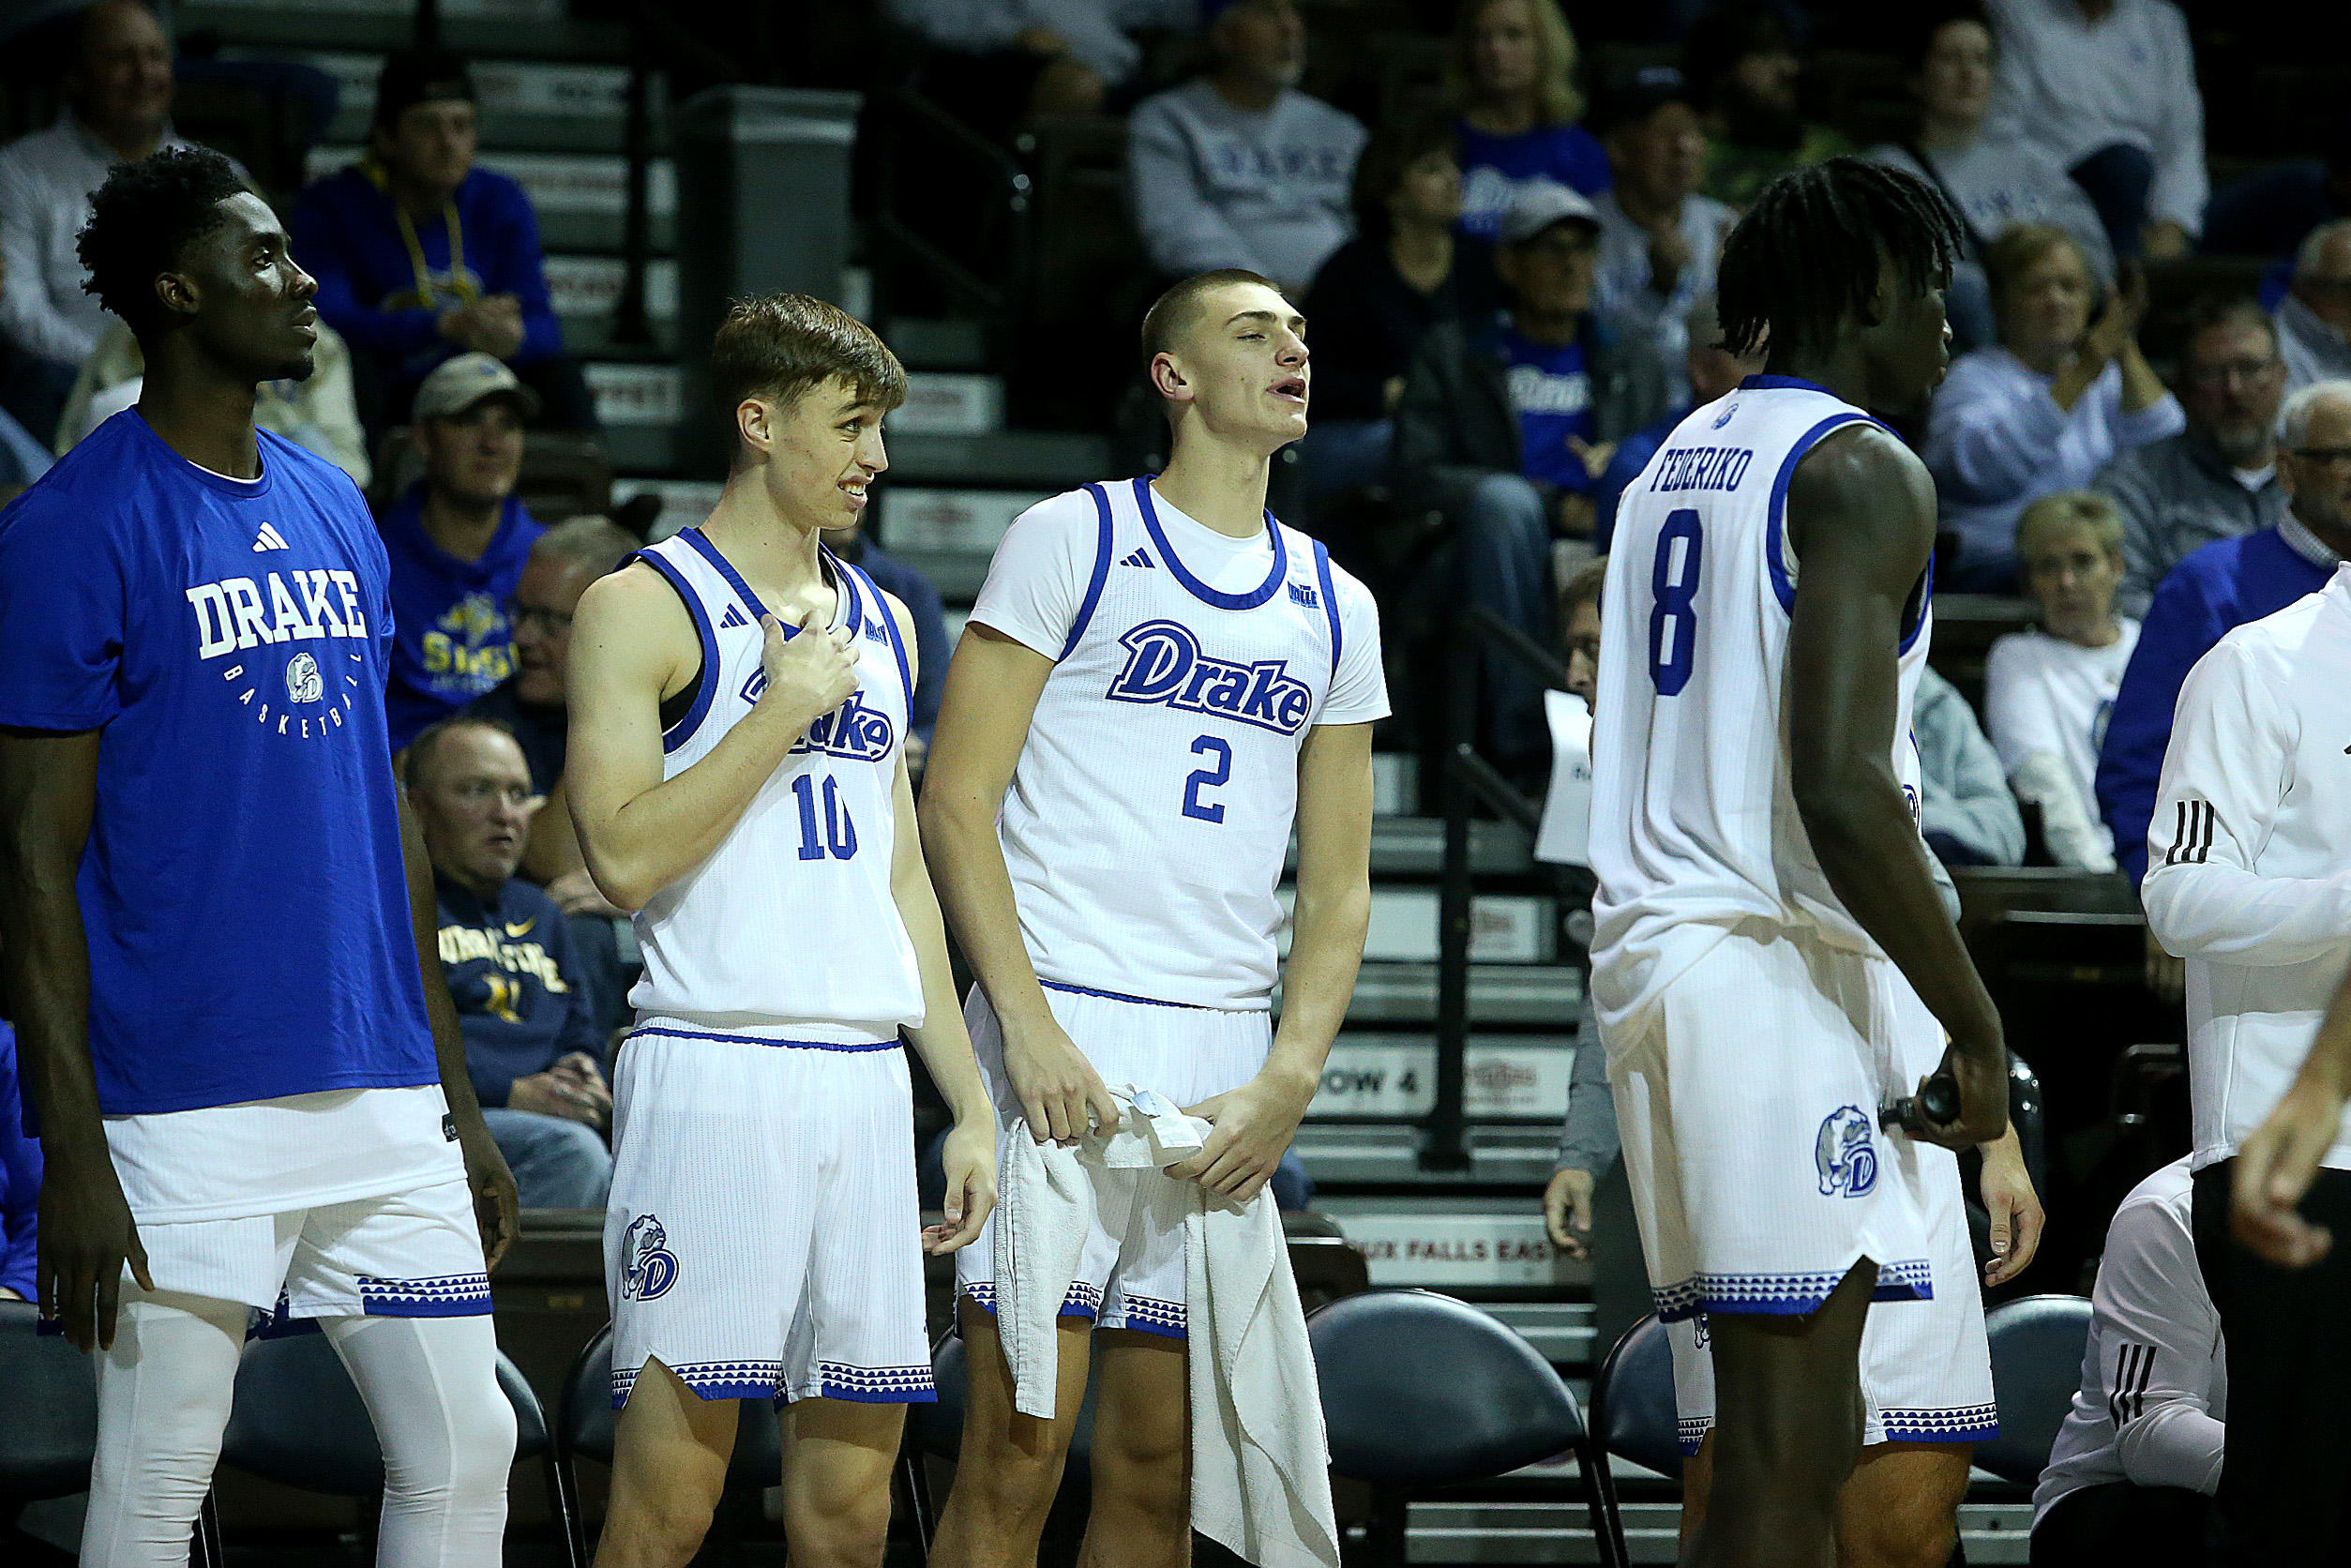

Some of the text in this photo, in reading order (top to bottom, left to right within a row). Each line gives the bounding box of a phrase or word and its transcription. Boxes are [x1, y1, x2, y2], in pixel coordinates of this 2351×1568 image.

[1650, 445, 1755, 492] FEDERIKO
[185, 569, 369, 660] DRAKE
[1649, 507, 1704, 697] 8
[223, 654, 362, 739] BASKETBALL
[1105, 619, 1313, 737] Drake
[791, 774, 858, 861] 10
[1182, 734, 1233, 824] 2
[1321, 1070, 1418, 1095] OW 4
[1844, 1144, 1879, 1199] D
[637, 1248, 680, 1302] D
[1407, 1239, 1485, 1261] FALLS
[1498, 1239, 1546, 1262] EAS
